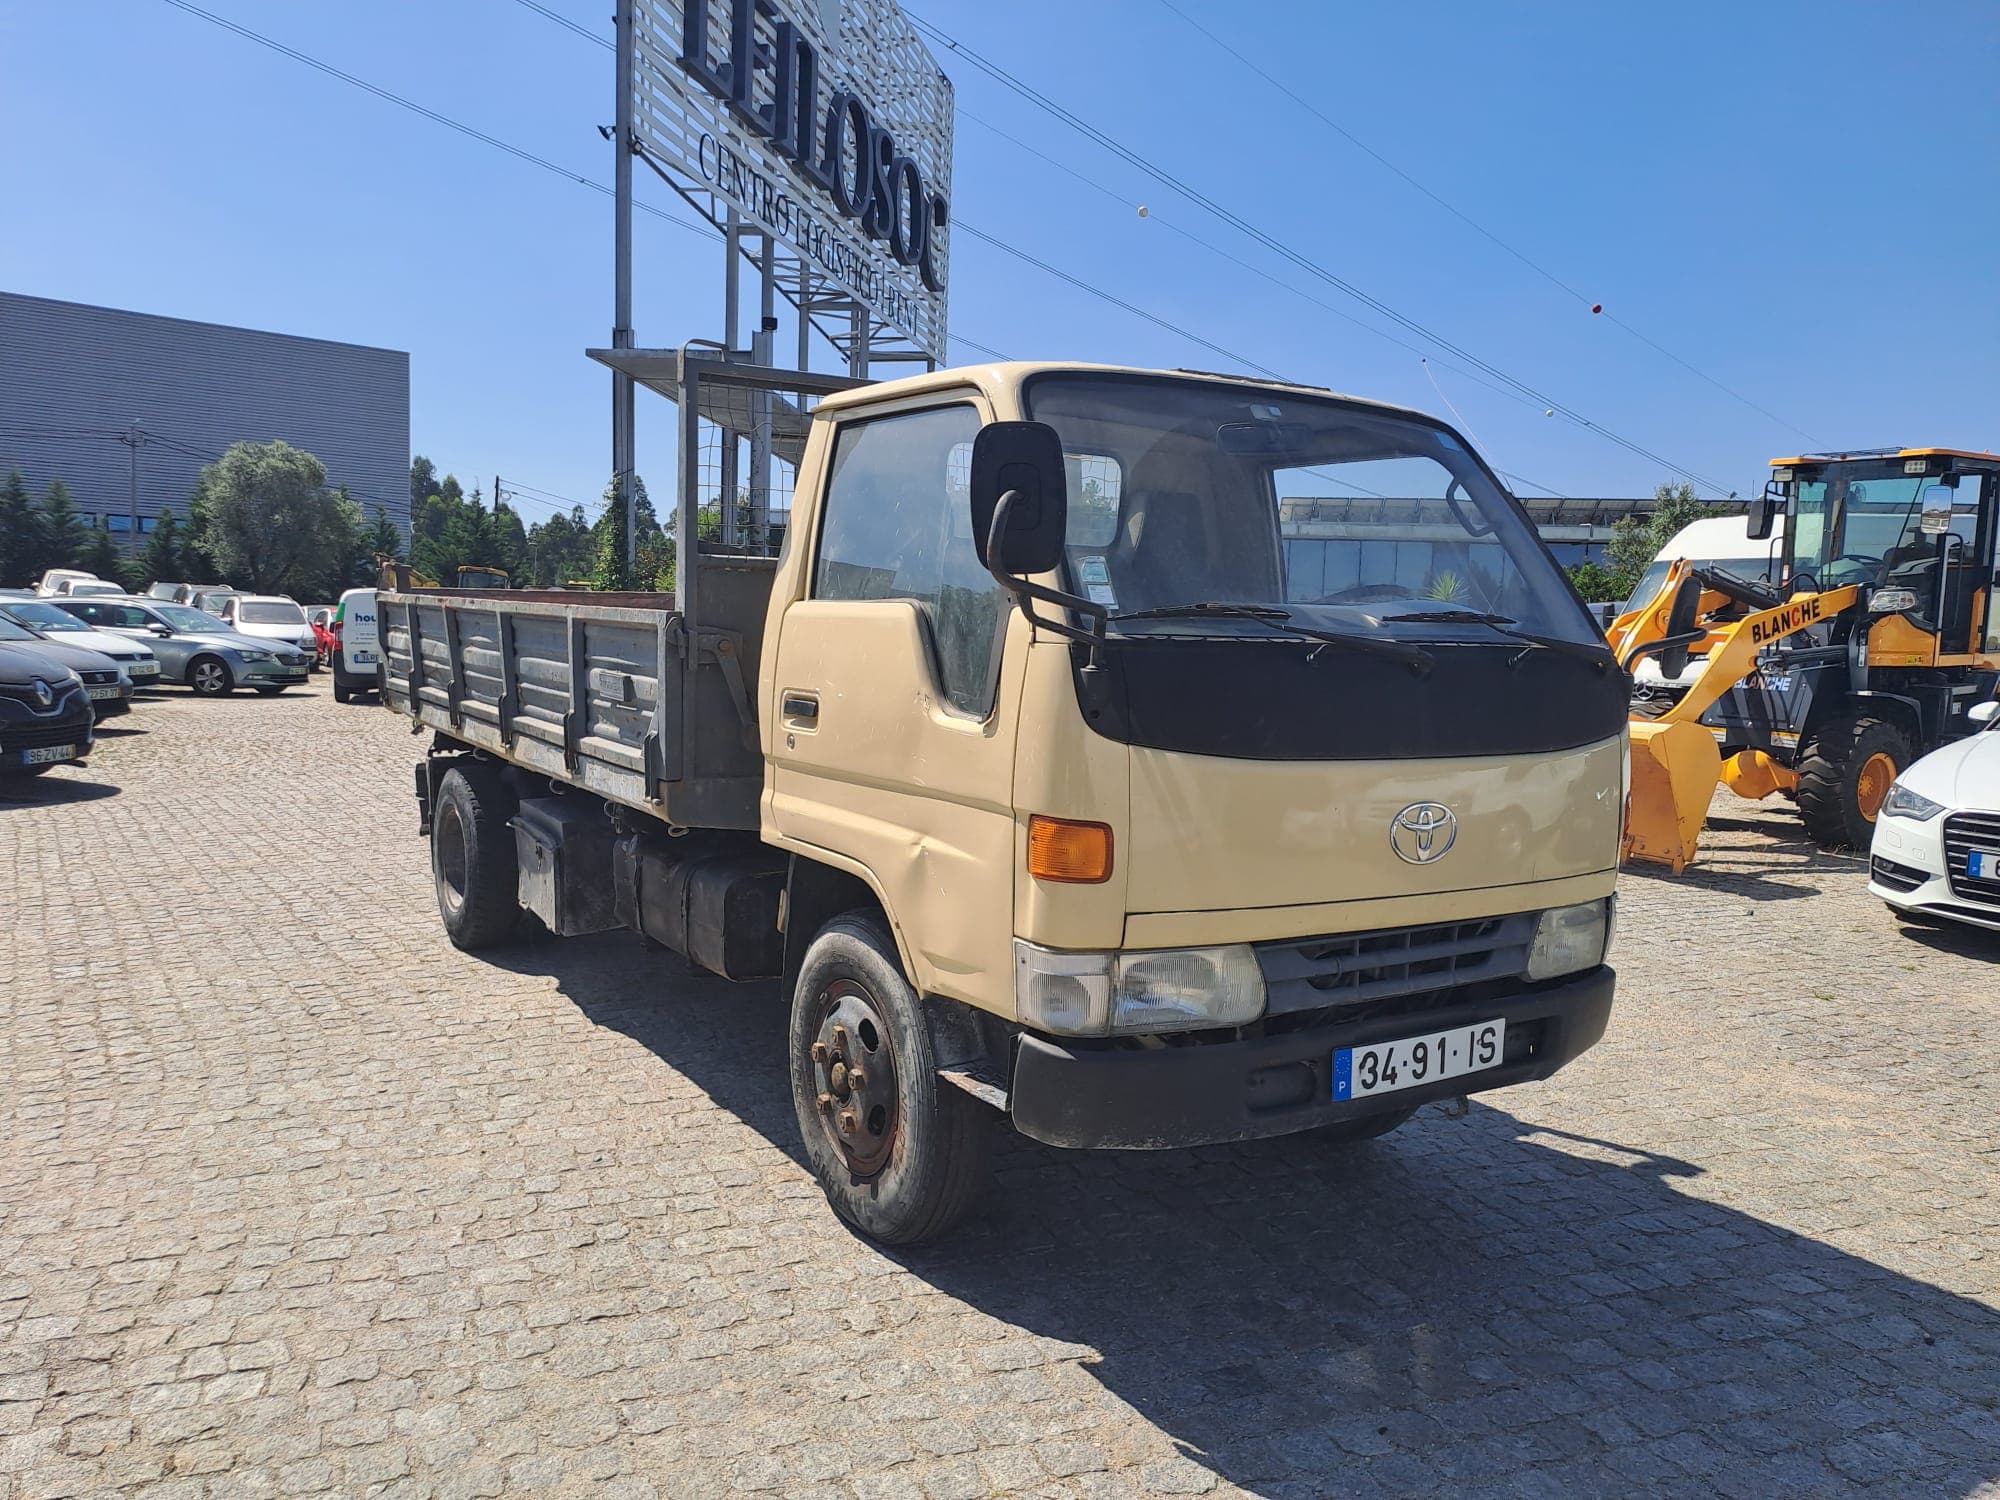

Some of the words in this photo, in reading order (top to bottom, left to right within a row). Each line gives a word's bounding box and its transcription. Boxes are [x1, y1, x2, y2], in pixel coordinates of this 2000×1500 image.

[699, 133, 789, 237] CENTRO
[1752, 598, 1821, 644] BLANCHE
[1338, 1080, 1346, 1093] P
